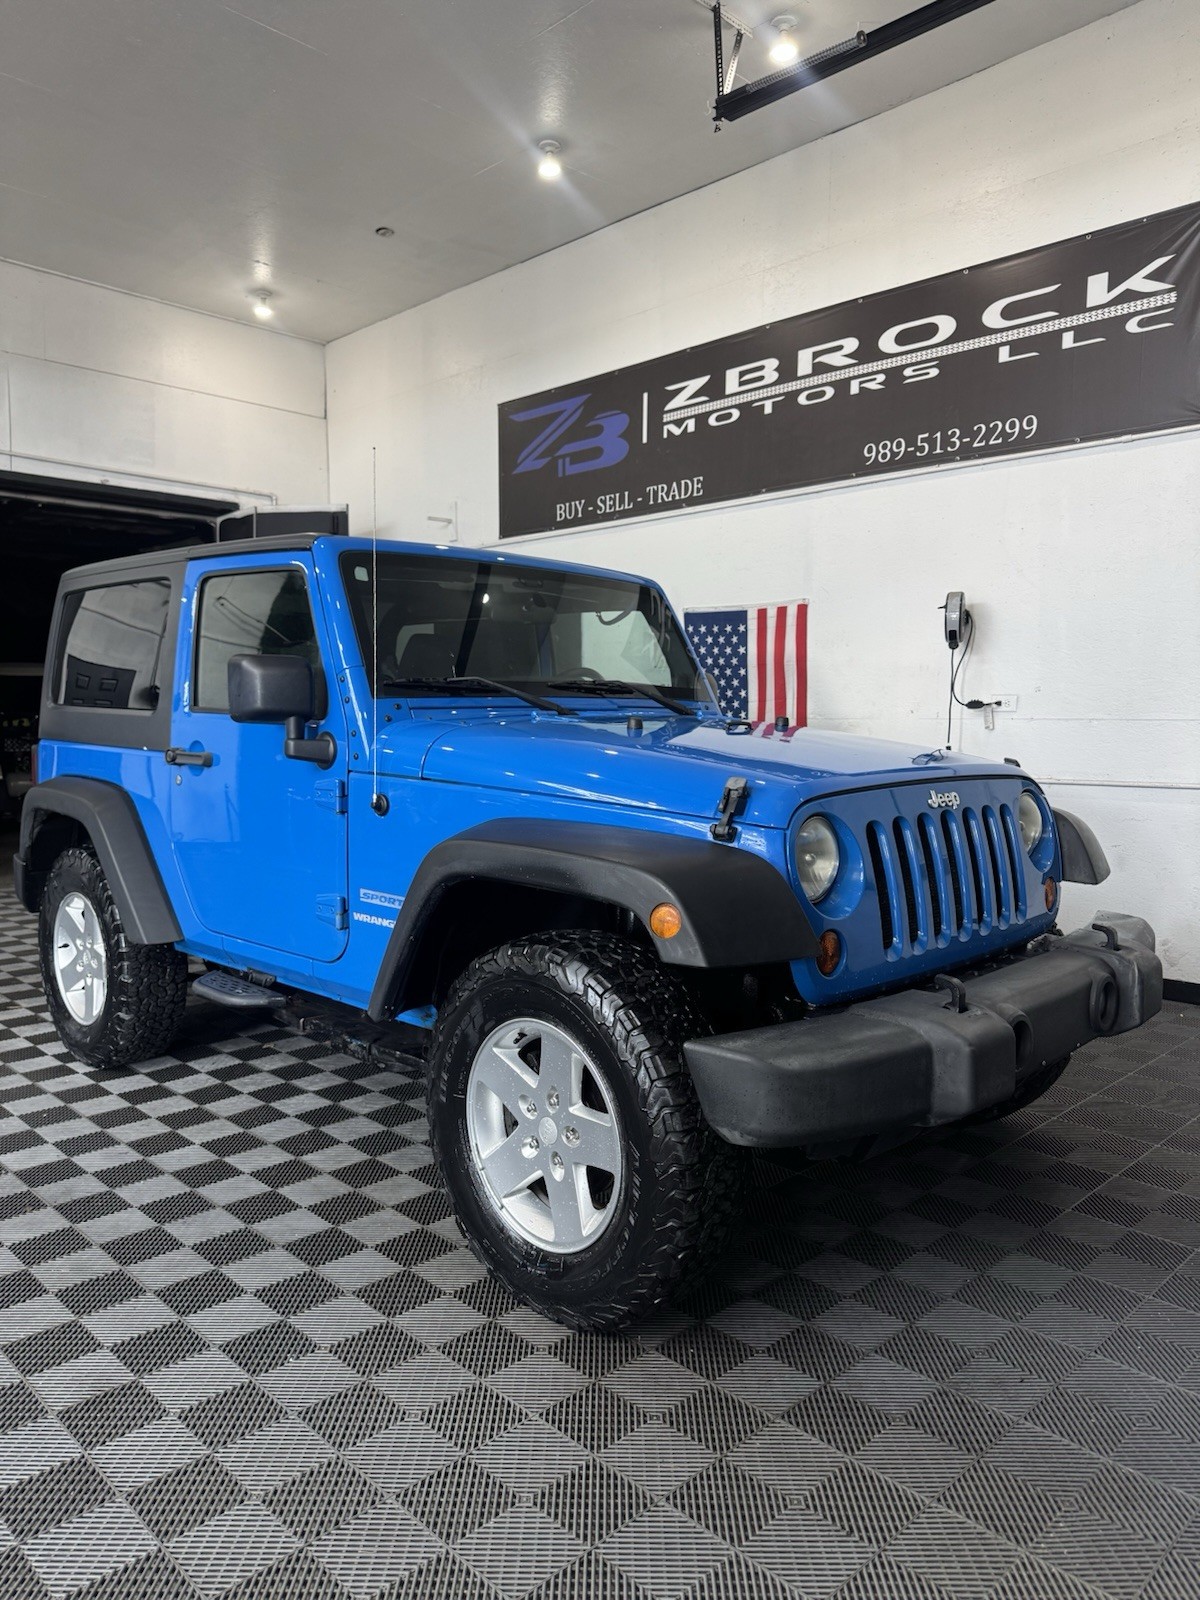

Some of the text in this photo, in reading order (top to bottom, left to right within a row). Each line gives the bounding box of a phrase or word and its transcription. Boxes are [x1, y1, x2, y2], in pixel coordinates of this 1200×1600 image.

[663, 254, 1177, 412] ZBROCK
[662, 307, 1176, 439] MOTORS LLC
[863, 414, 1039, 467] 989-513-2299
[556, 499, 585, 522] BUY
[596, 491, 634, 515] SELL
[646, 476, 704, 505] TRADE
[928, 789, 960, 810] Jeep
[360, 891, 404, 907] SPORT
